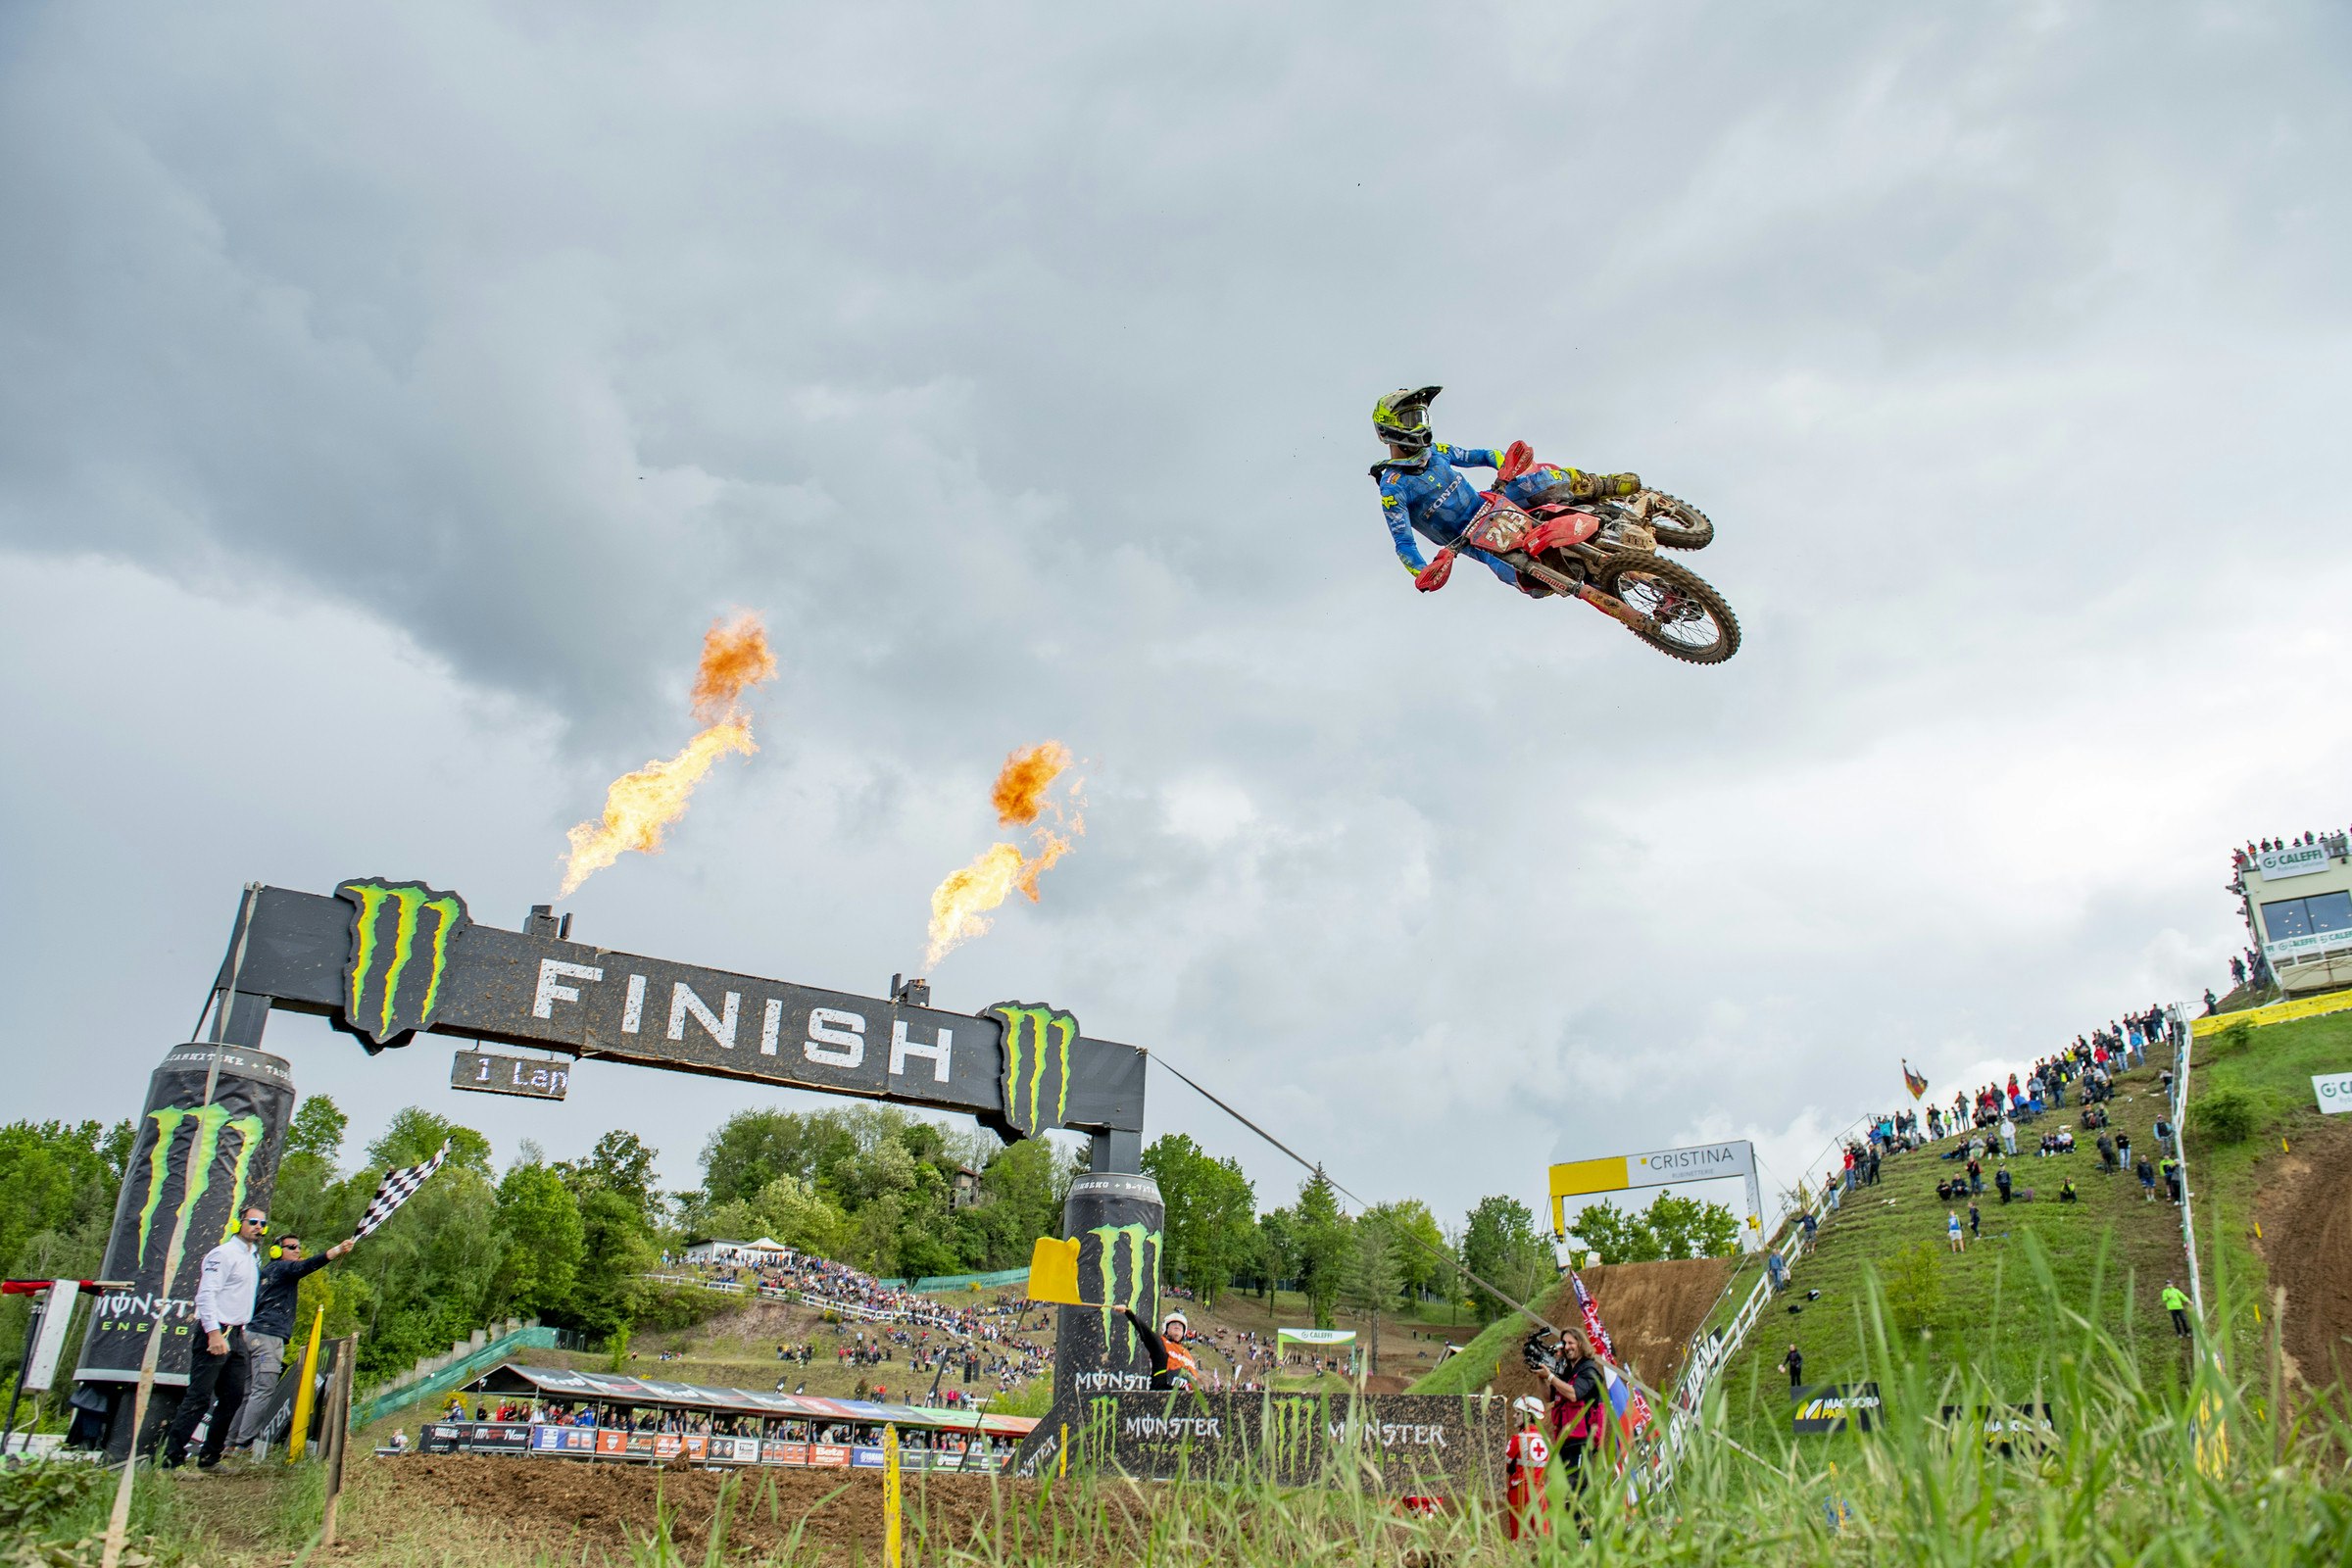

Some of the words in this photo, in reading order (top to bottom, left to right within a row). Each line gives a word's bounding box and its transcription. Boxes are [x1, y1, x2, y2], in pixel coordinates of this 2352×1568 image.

[1423, 475, 1463, 519] HONDA
[2278, 849, 2324, 865] CALEFFI
[532, 957, 954, 1083] FINISH
[475, 1057, 490, 1081] 1
[512, 1061, 568, 1095] Lap
[1650, 1147, 1735, 1170] CRISTINA
[102, 1321, 189, 1336] ENERG
[1126, 1413, 1222, 1439] MONSTER
[1328, 1418, 1447, 1447] MNSTER
